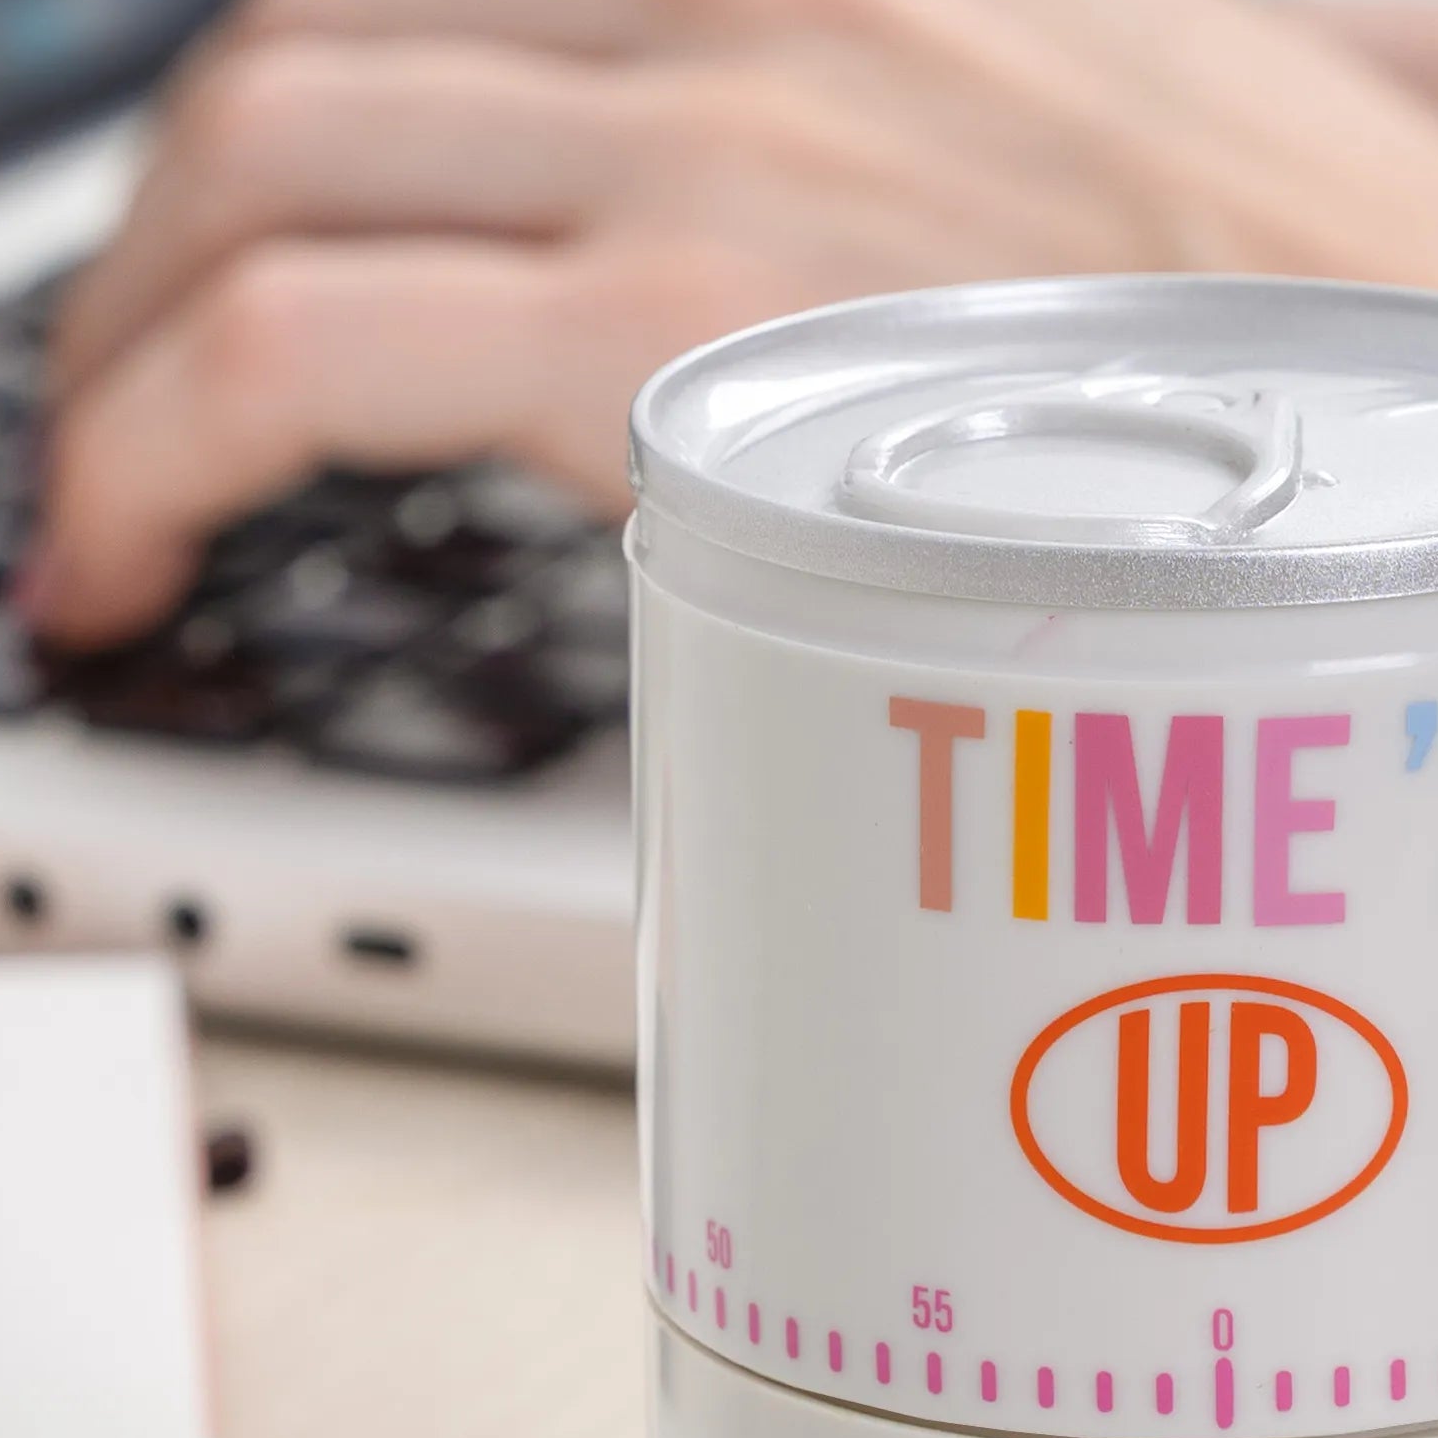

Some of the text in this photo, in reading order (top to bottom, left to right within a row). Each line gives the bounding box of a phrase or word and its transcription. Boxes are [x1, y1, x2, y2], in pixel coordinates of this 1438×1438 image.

[1115, 1000, 1318, 1215] UP
[706, 1219, 732, 1271] 50
[910, 1286, 954, 1334] 55
[1211, 1307, 1235, 1353] 0
